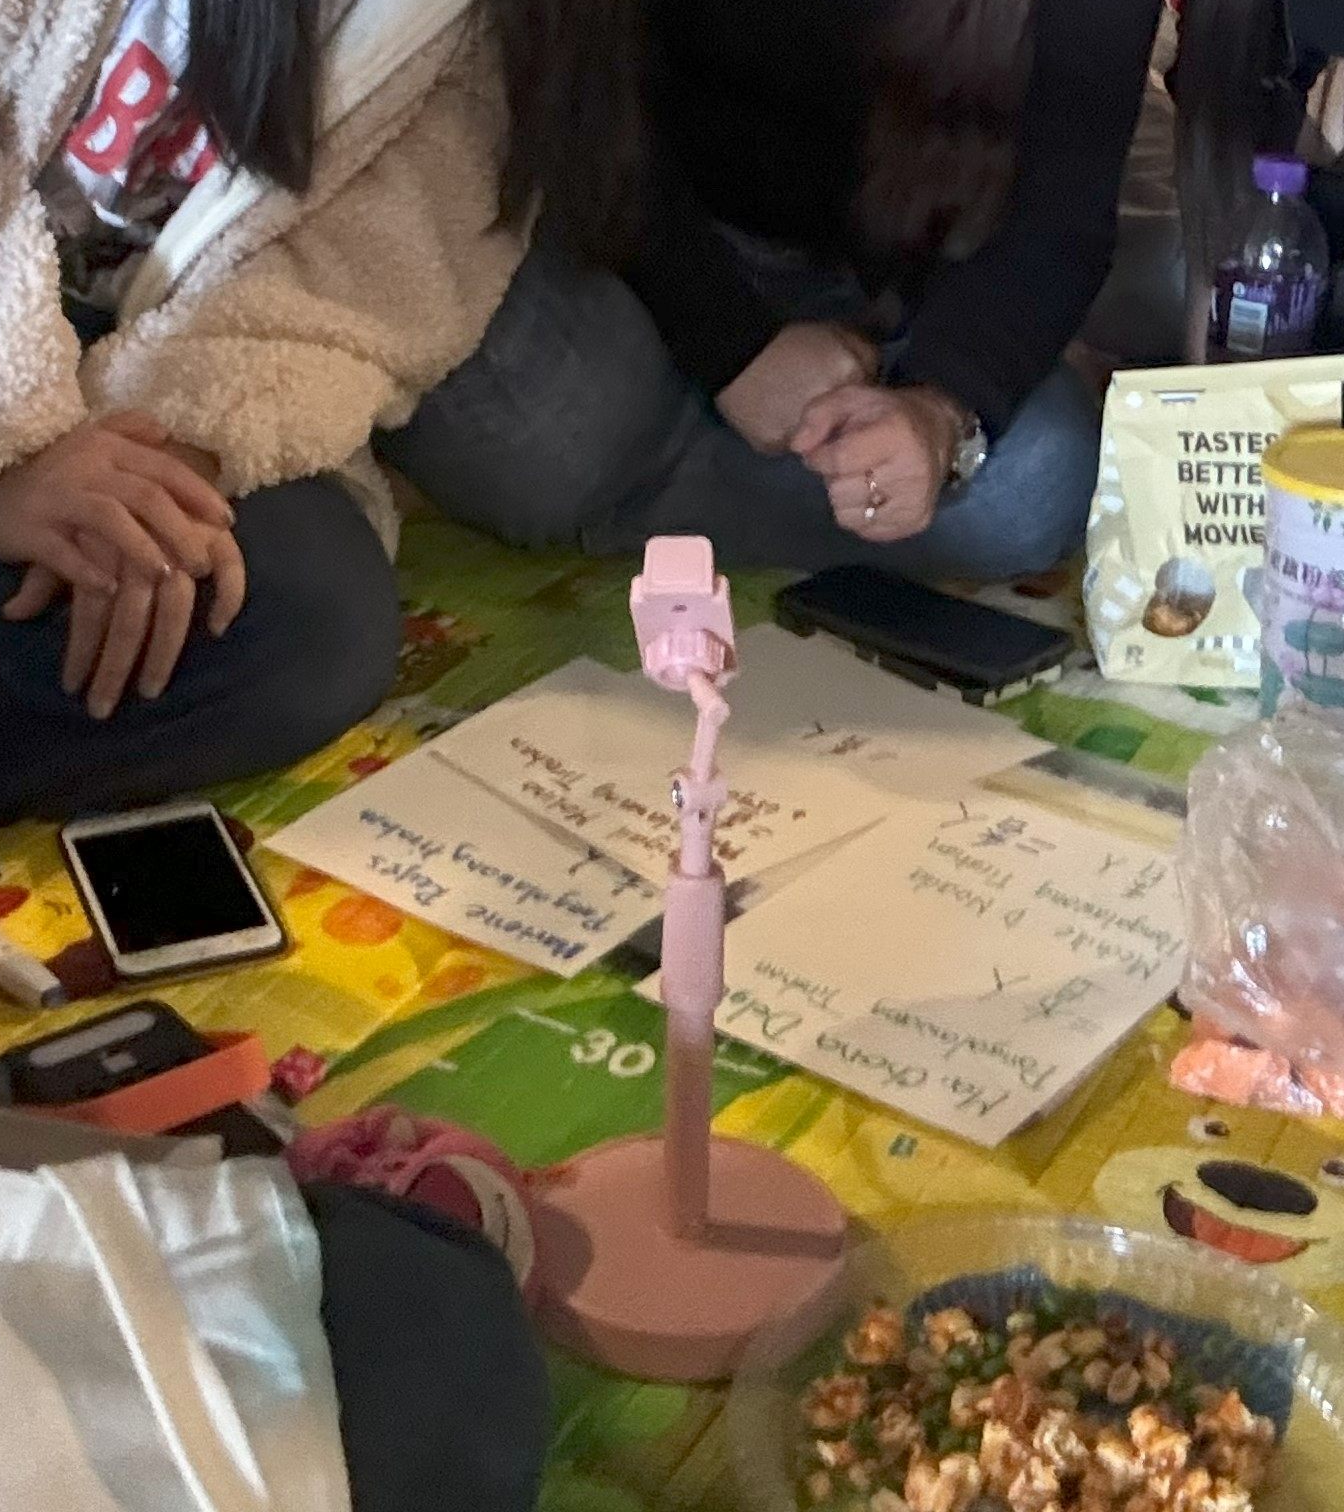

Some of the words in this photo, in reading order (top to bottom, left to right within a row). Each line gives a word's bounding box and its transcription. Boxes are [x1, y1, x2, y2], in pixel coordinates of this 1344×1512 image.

[1177, 460, 1263, 484] BETTE
[1196, 491, 1265, 516] WITH
[1184, 521, 1267, 545] MOVIE
[570, 1028, 656, 1078] 30
